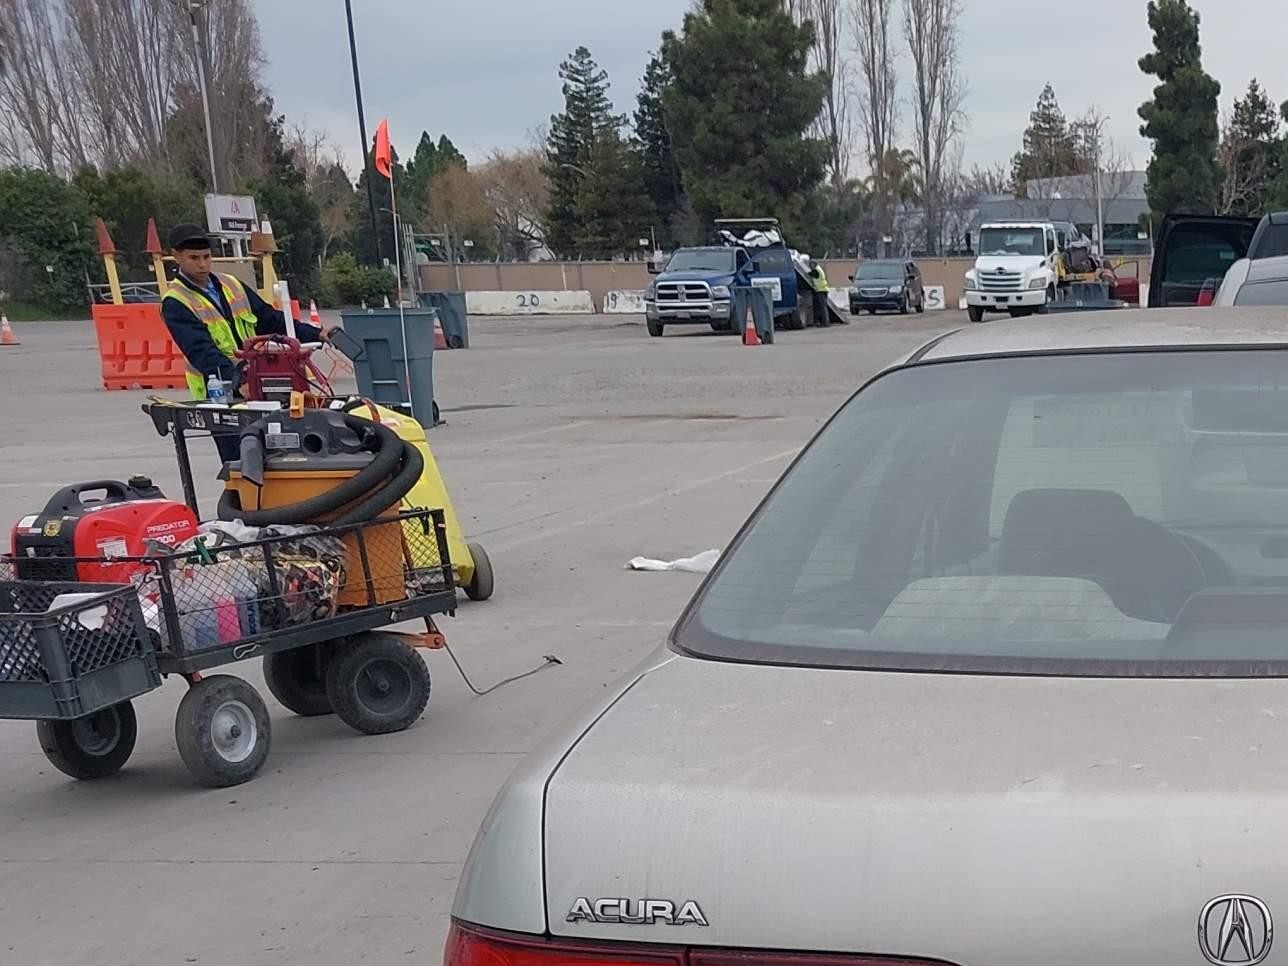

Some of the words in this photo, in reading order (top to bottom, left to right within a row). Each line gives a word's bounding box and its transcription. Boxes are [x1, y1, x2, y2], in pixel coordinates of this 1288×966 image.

[516, 294, 540, 307] 20
[146, 519, 190, 533] PREDATOR
[566, 897, 709, 926] ACURA
